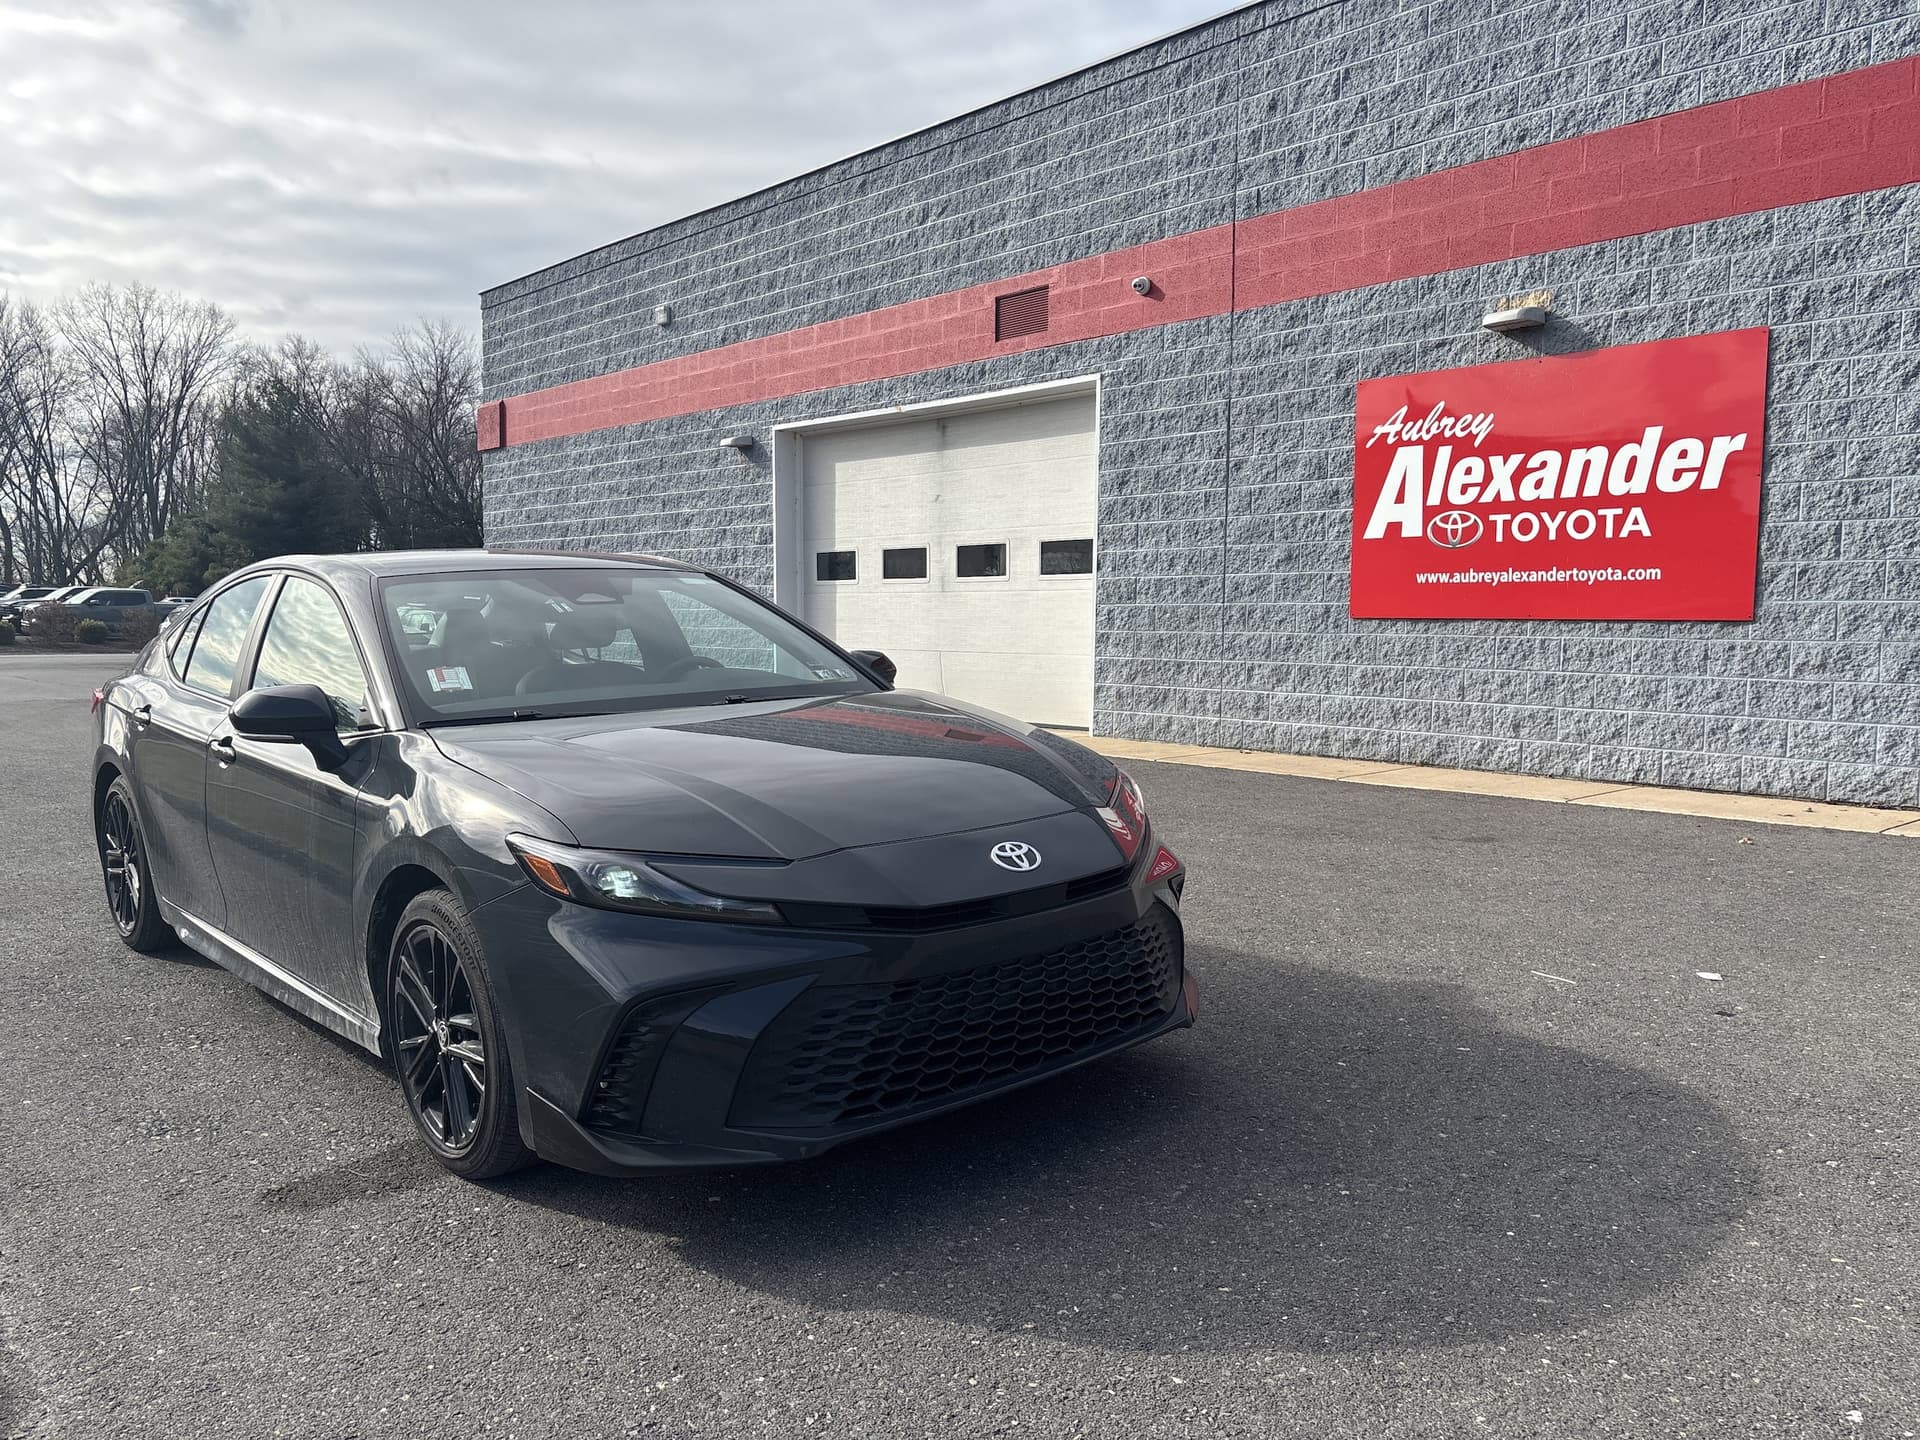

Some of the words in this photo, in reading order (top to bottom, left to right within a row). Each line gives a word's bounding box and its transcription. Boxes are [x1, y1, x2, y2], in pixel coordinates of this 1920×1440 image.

[1366, 400, 1495, 449] Aubrey
[1362, 426, 1748, 540] Alexander
[1488, 506, 1652, 543] TOYOTA
[1416, 566, 1662, 587] www.aubreyalexandertoyota.com
